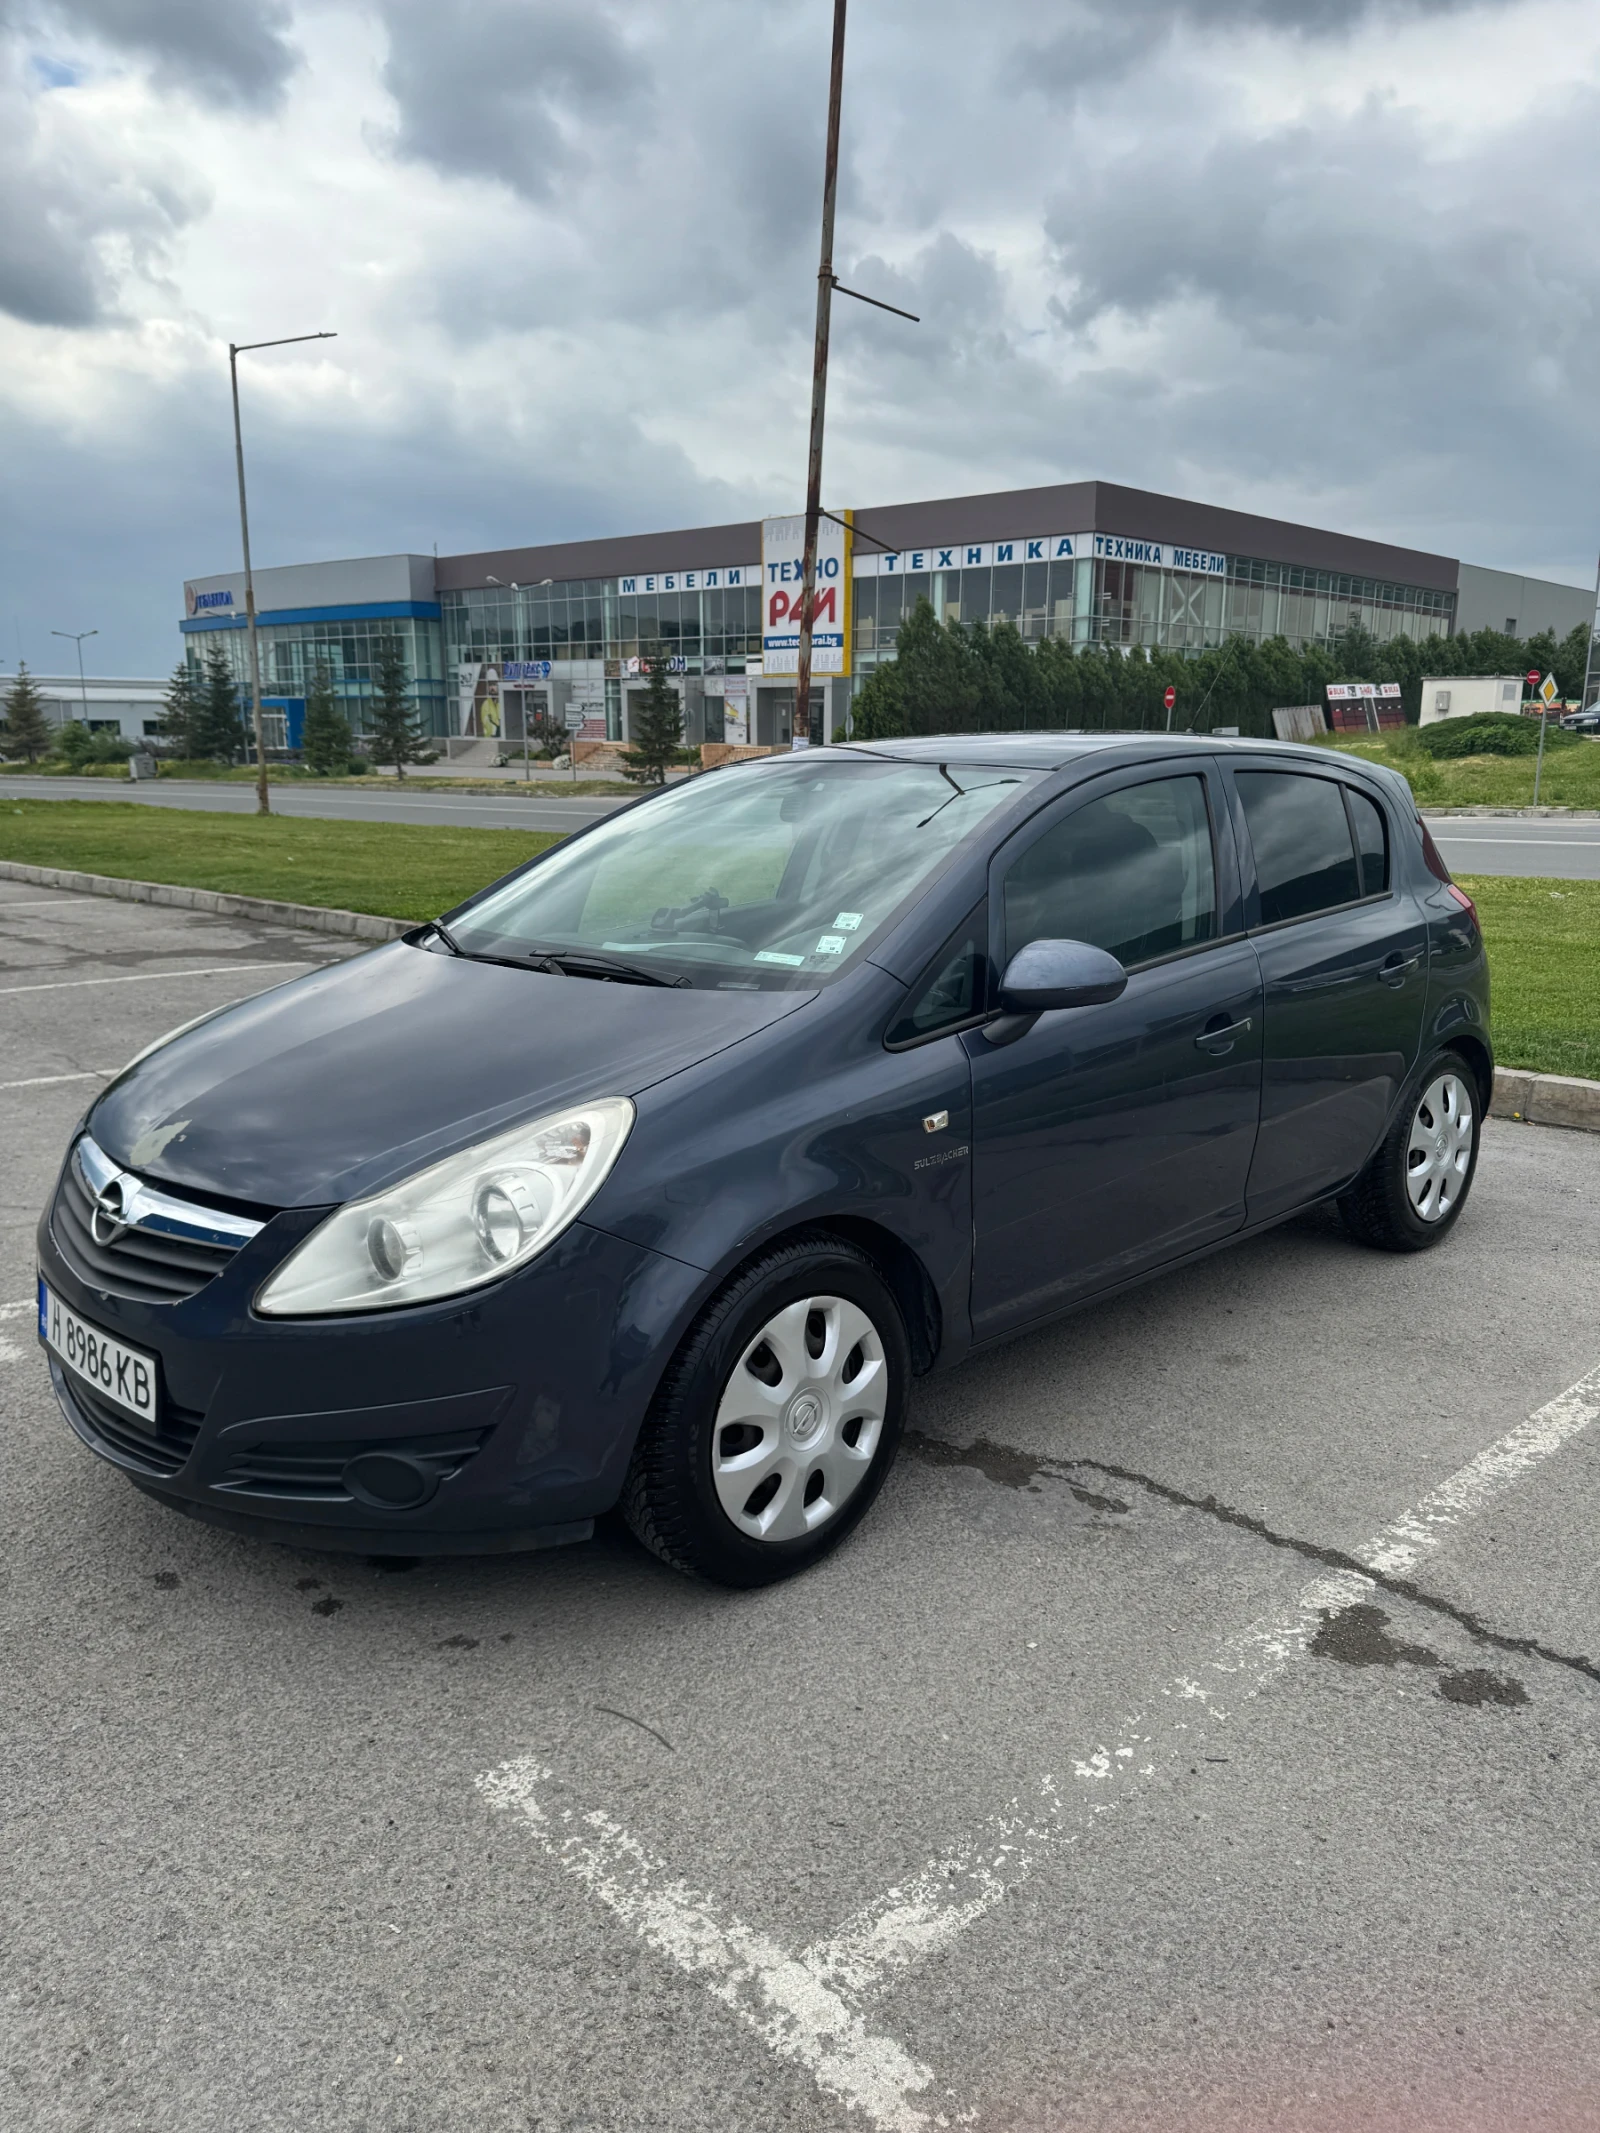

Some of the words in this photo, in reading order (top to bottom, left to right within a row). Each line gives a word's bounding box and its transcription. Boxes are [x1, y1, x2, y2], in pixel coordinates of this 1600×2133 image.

[884, 538, 1074, 572] ТЕХНИКА
[1095, 536, 1162, 564] ТЕХНИКА
[1173, 548, 1225, 573] МЕБЕЛИ
[622, 570, 741, 593] МЕБЕЛИ
[767, 635, 838, 648] www.tecorai.bg
